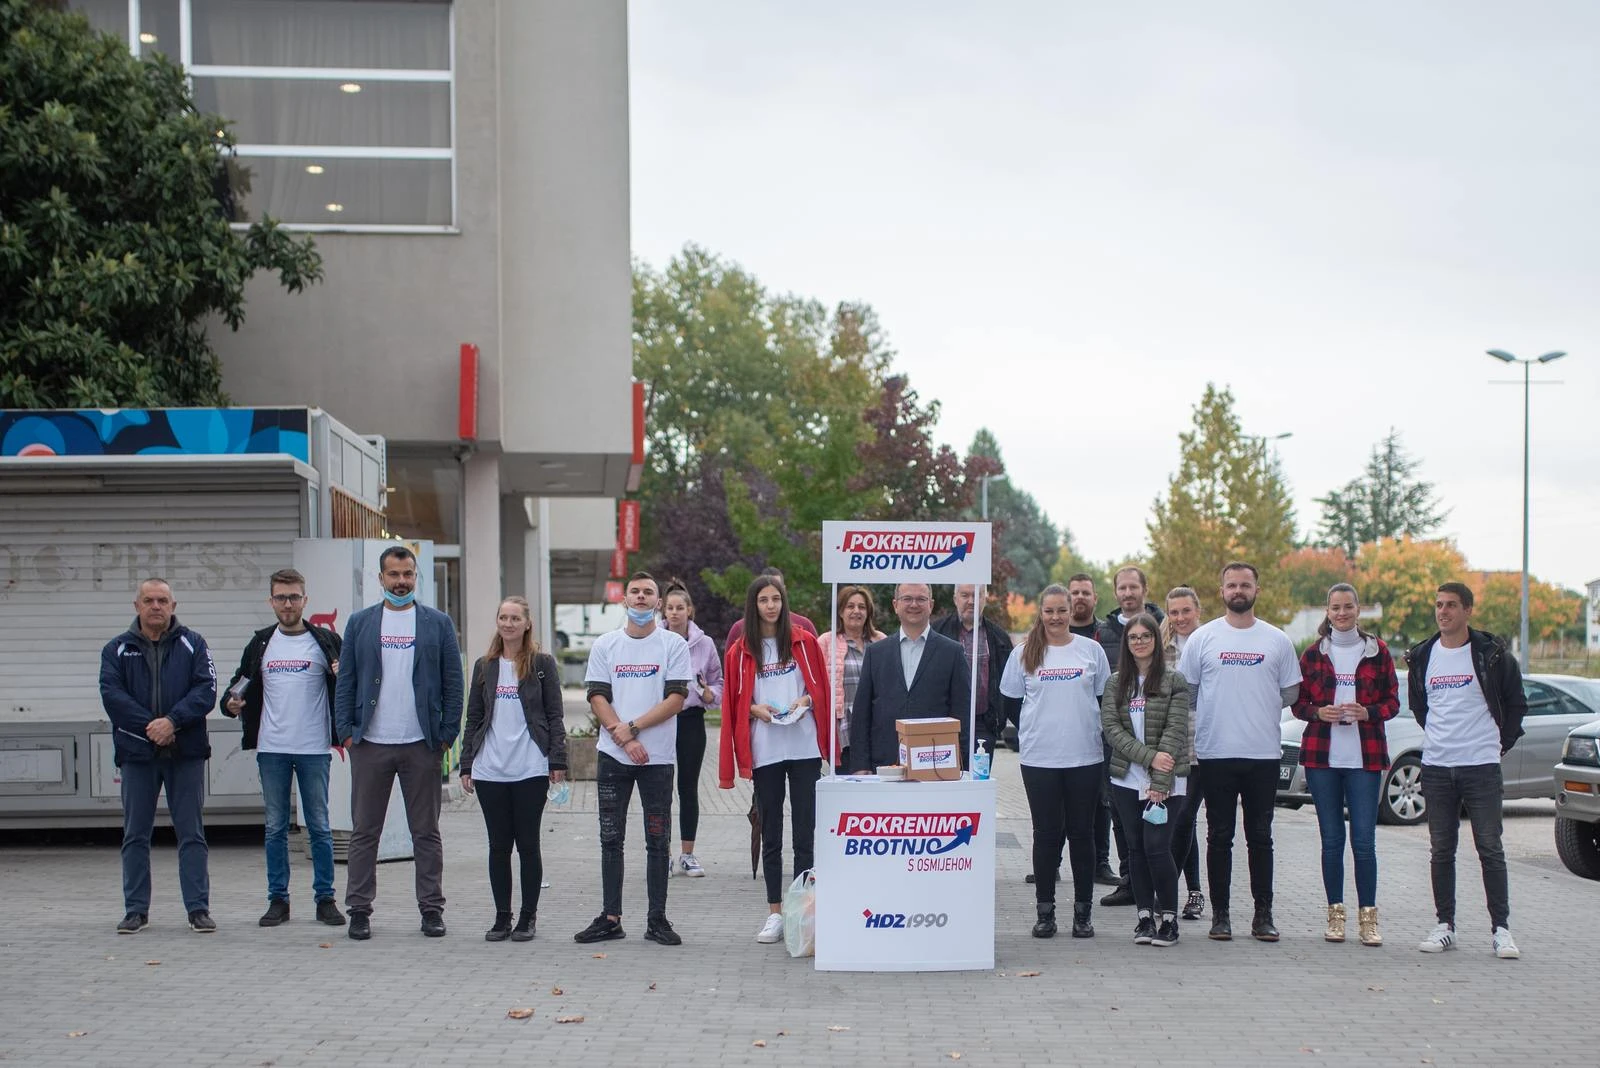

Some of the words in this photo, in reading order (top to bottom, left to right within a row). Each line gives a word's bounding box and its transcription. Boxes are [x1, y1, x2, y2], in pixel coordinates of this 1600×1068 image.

[850, 533, 967, 551] POKRENIMO
[849, 554, 938, 570] BROTNJO
[1222, 652, 1263, 660] POKRENIMO
[268, 666, 298, 674] BROTNJO
[1040, 668, 1081, 676] POKRENIMO
[1431, 675, 1472, 684] POKRENIMO
[1431, 682, 1460, 690] BROTNJO
[845, 815, 972, 834] POKRENIMO
[844, 838, 942, 856] BROTNJO
[908, 858, 914, 871] S
[917, 857, 972, 872] OSMIJEHOM
